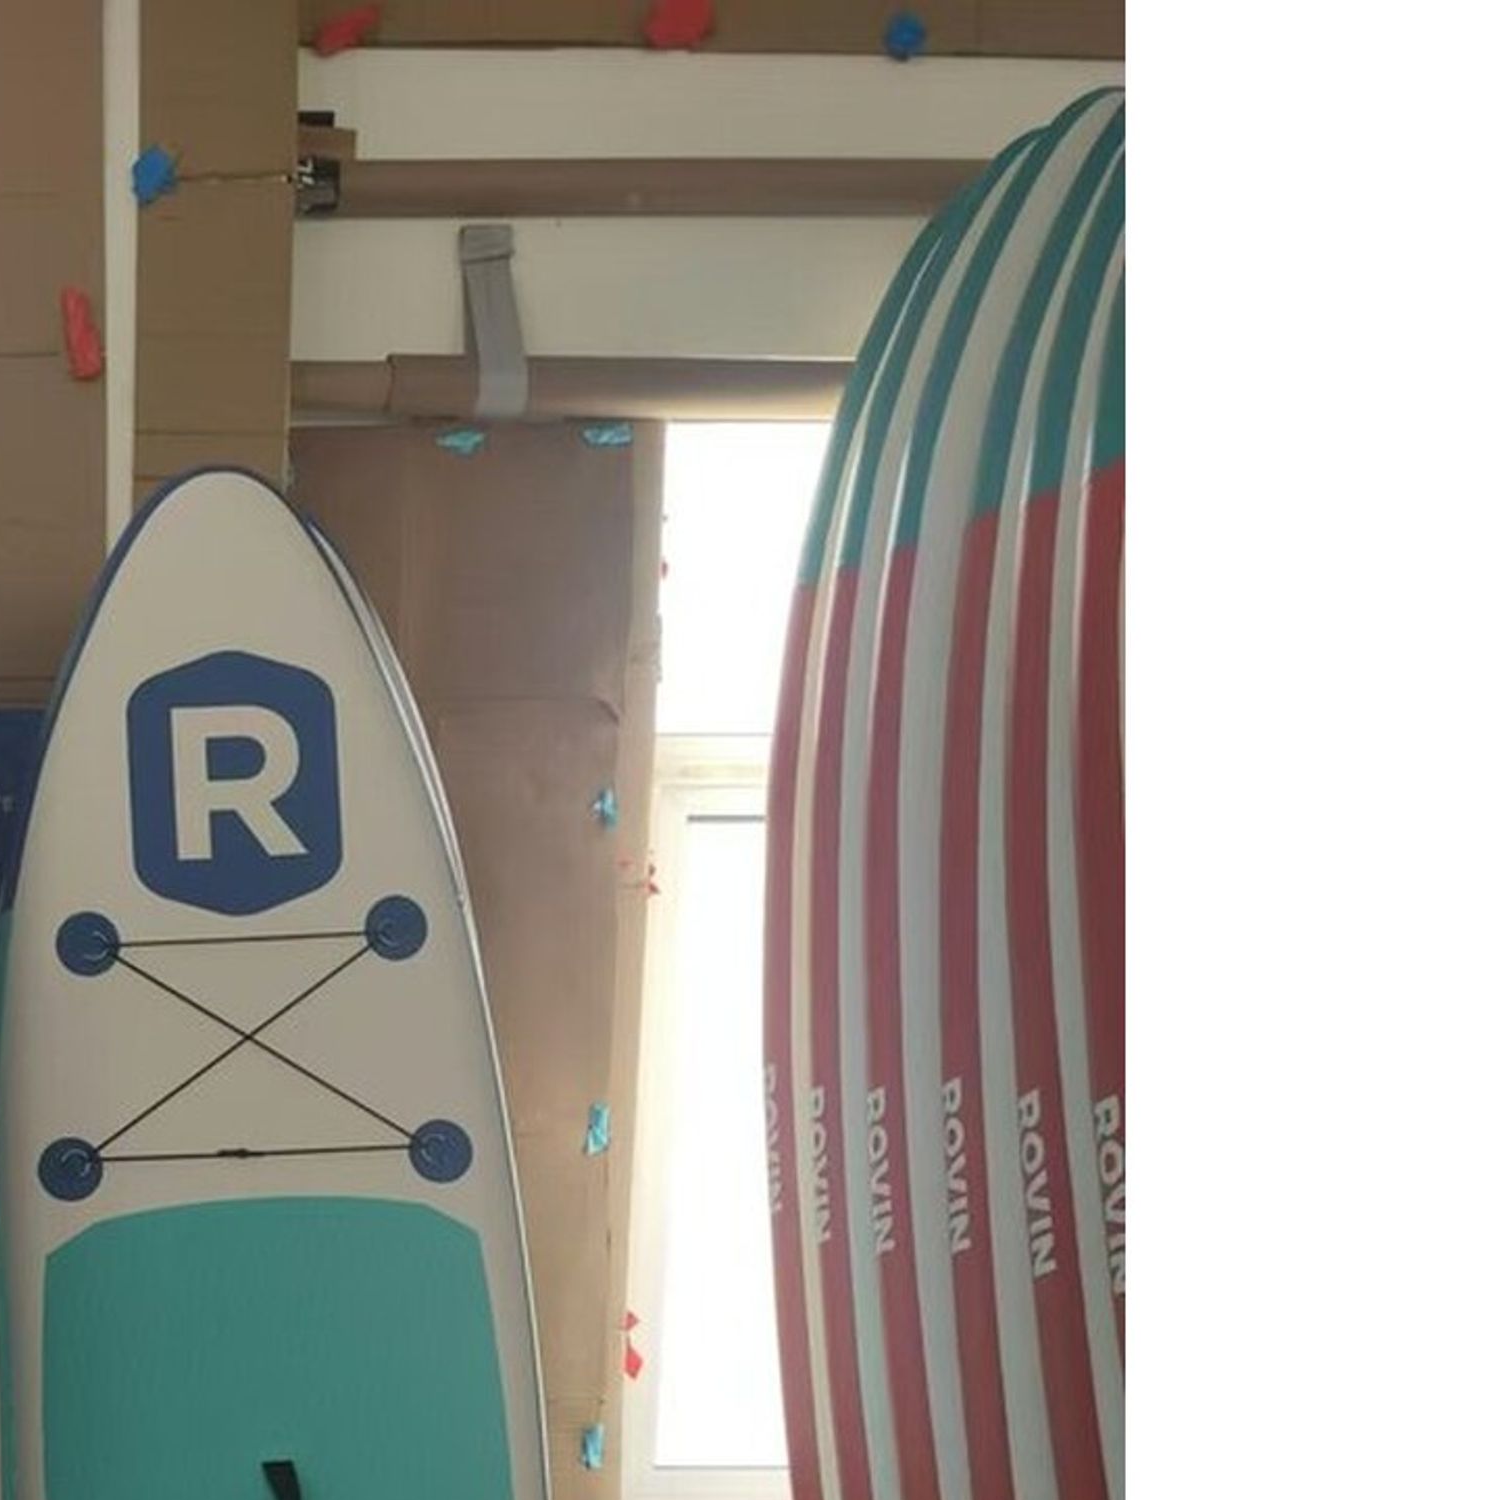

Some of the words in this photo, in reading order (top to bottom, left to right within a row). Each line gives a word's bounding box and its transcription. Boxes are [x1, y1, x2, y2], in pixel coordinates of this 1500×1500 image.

[171, 706, 308, 860] R
[808, 1086, 831, 1243] ROVIN
[866, 1086, 895, 1252] ROVIN
[940, 1077, 972, 1255] ROVIN
[1017, 1089, 1057, 1278] ROVIN
